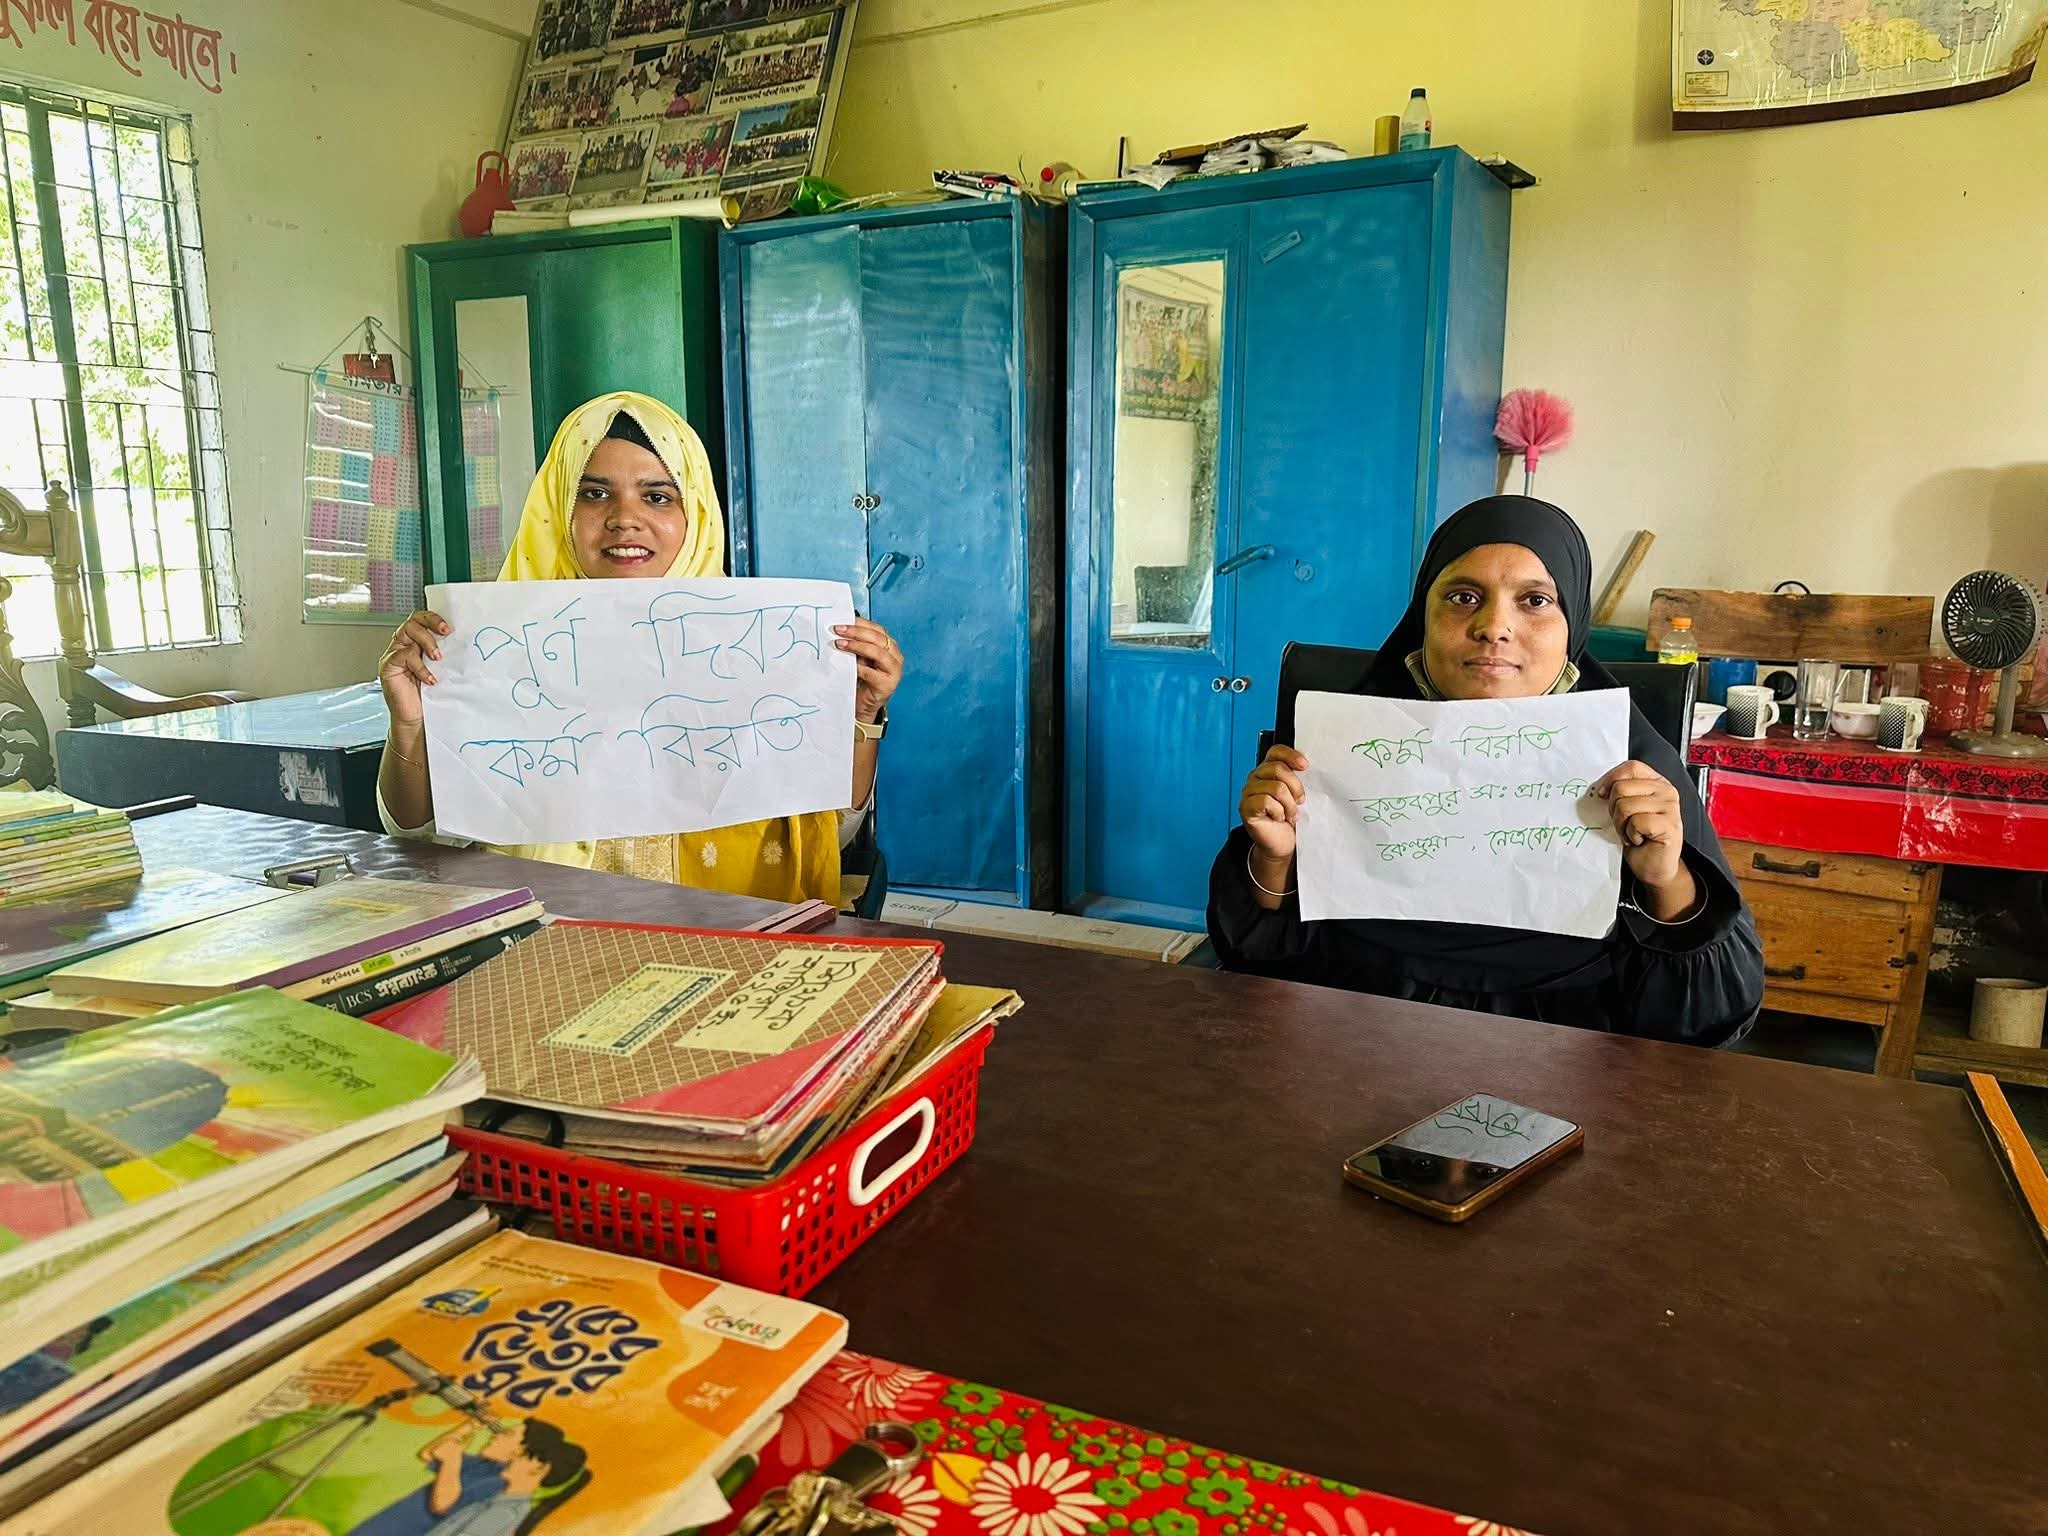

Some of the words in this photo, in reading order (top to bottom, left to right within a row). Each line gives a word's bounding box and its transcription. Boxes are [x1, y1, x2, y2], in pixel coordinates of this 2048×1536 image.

[82, 0, 142, 77] বয়ে
[632, 591, 833, 679] দিবস
[459, 712, 603, 788] কর্ম
[617, 694, 821, 773] বিরতি
[1351, 728, 1433, 769] কর্ম
[1450, 725, 1568, 760] বিরতি
[1349, 789, 1462, 827] কুতুবপুর
[345, 990, 373, 1009] BCS
